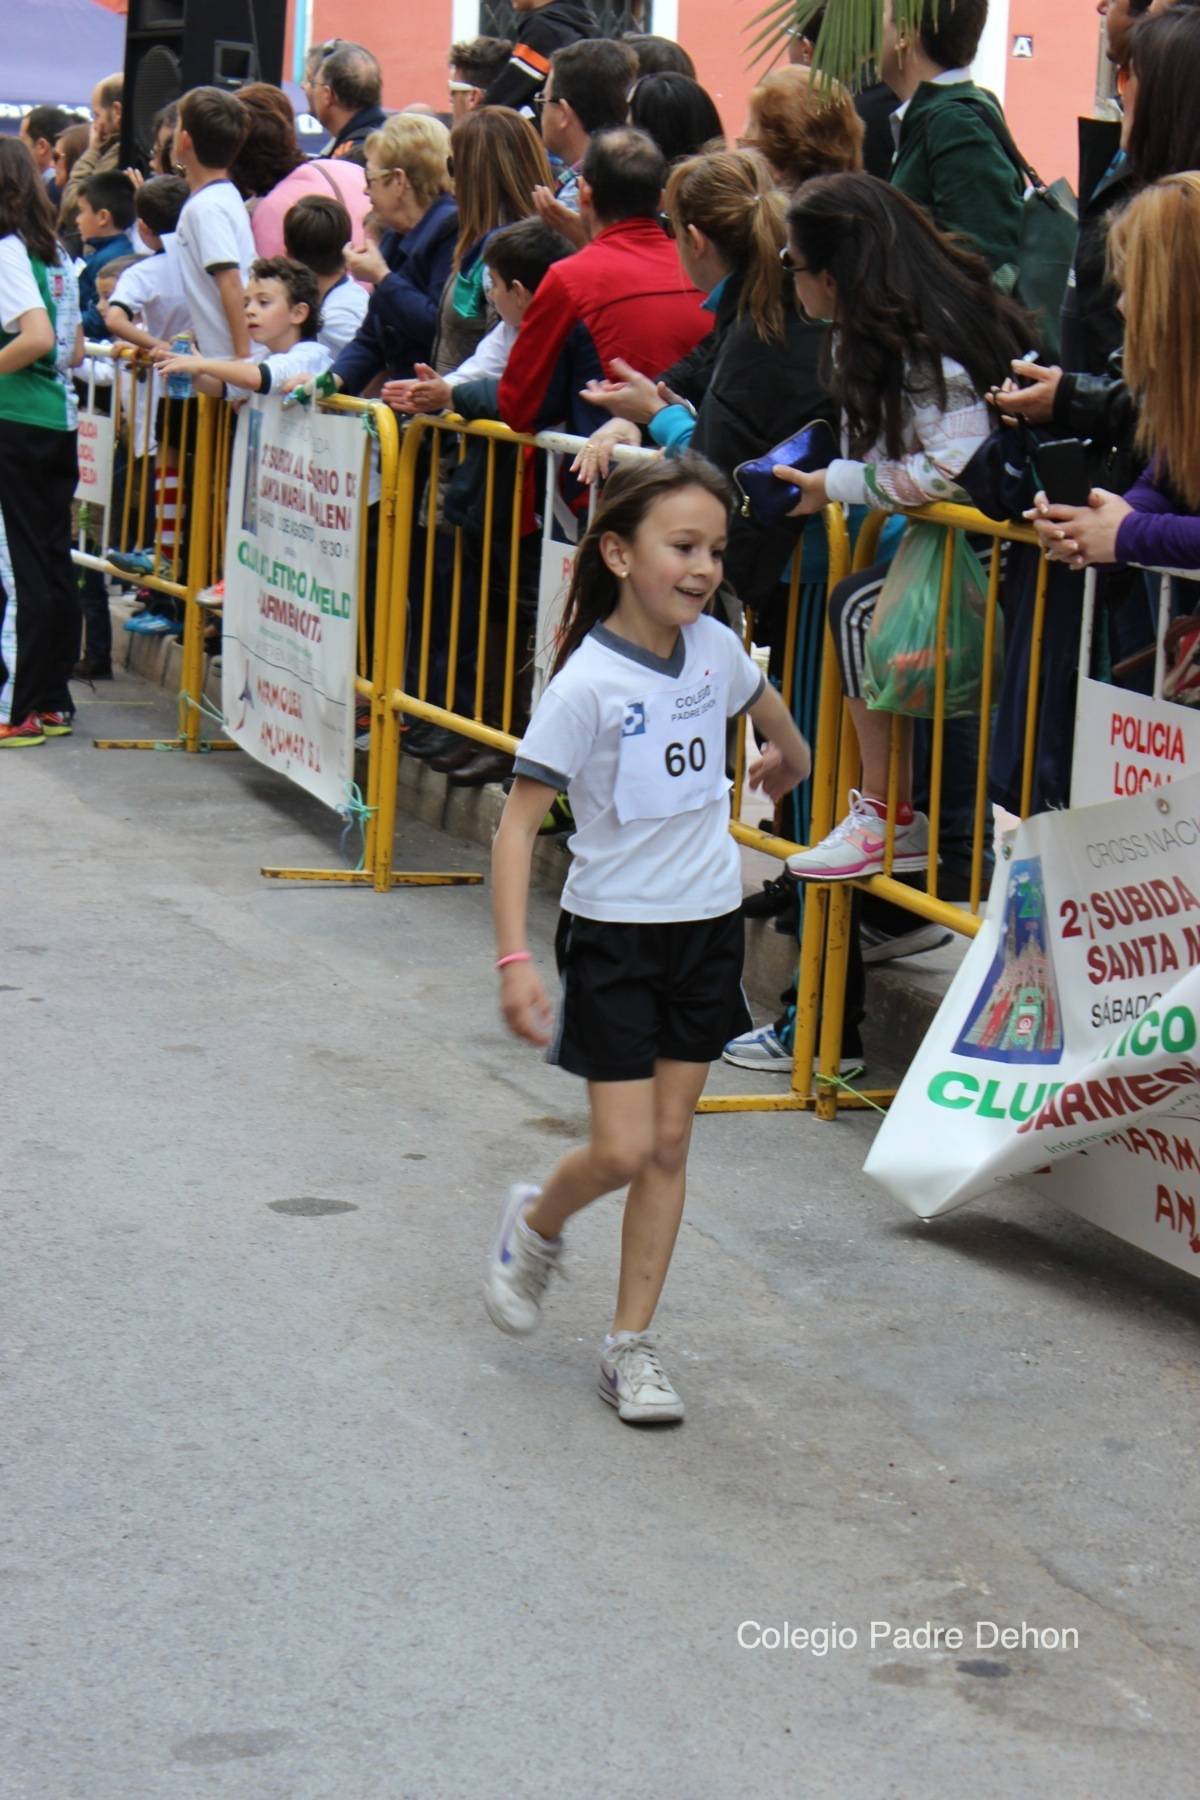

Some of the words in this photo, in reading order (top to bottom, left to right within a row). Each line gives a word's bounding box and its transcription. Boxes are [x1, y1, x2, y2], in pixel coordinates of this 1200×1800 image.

[665, 736, 706, 778] 60
[1110, 712, 1186, 764] POLICIA
[1086, 834, 1149, 869] CROSS
[1089, 875, 1200, 931] SUBIDA
[1086, 932, 1180, 986] SANTA
